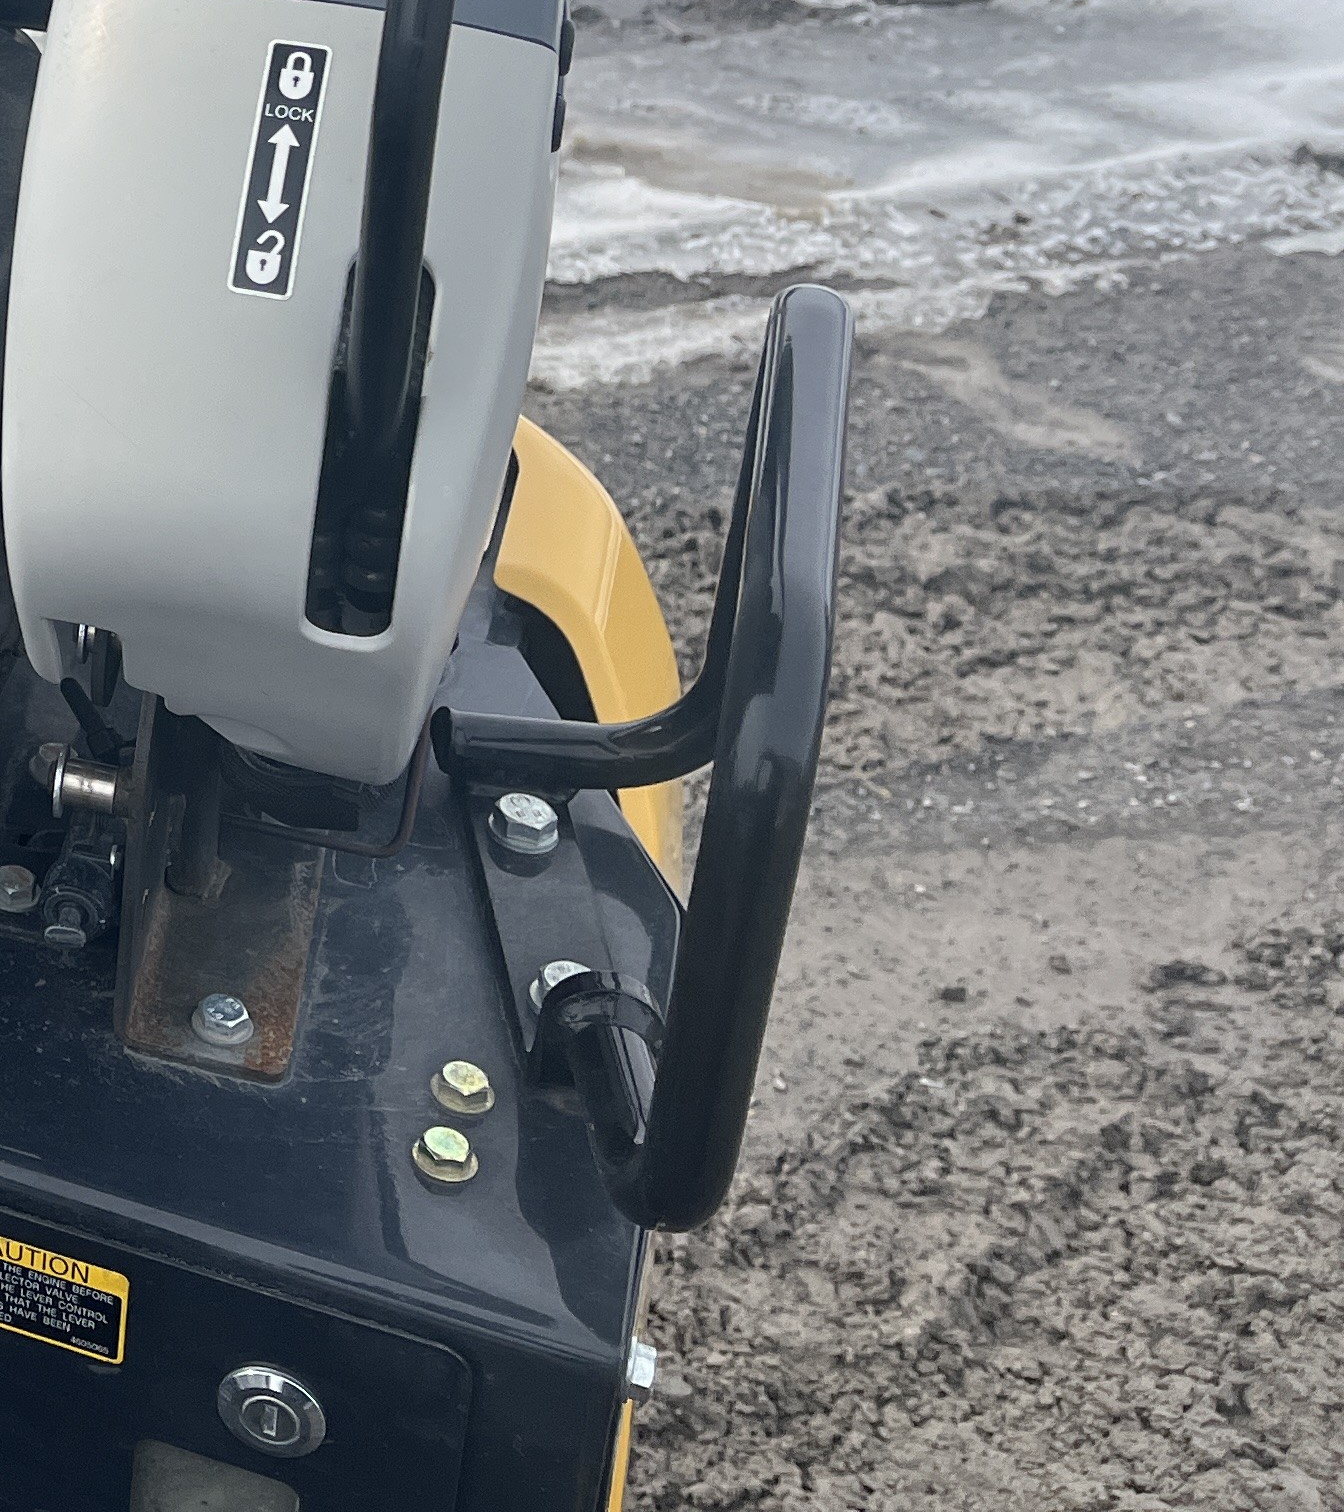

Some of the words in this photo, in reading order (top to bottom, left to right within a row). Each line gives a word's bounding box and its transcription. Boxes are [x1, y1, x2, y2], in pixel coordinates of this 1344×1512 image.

[264, 103, 314, 123] LOCK
[2, 1261, 22, 1276] THE
[28, 1270, 66, 1290] ENGINE
[71, 1284, 114, 1306] BEFORE
[4, 1292, 31, 1309] THAT
[37, 1303, 57, 1318] THE
[62, 1312, 95, 1330] LEVER
[9, 1305, 37, 1322] HAVE
[42, 1315, 71, 1332] BEEN
[20, 1287, 53, 1306] LEVER
[58, 1300, 108, 1324] CONTROL
